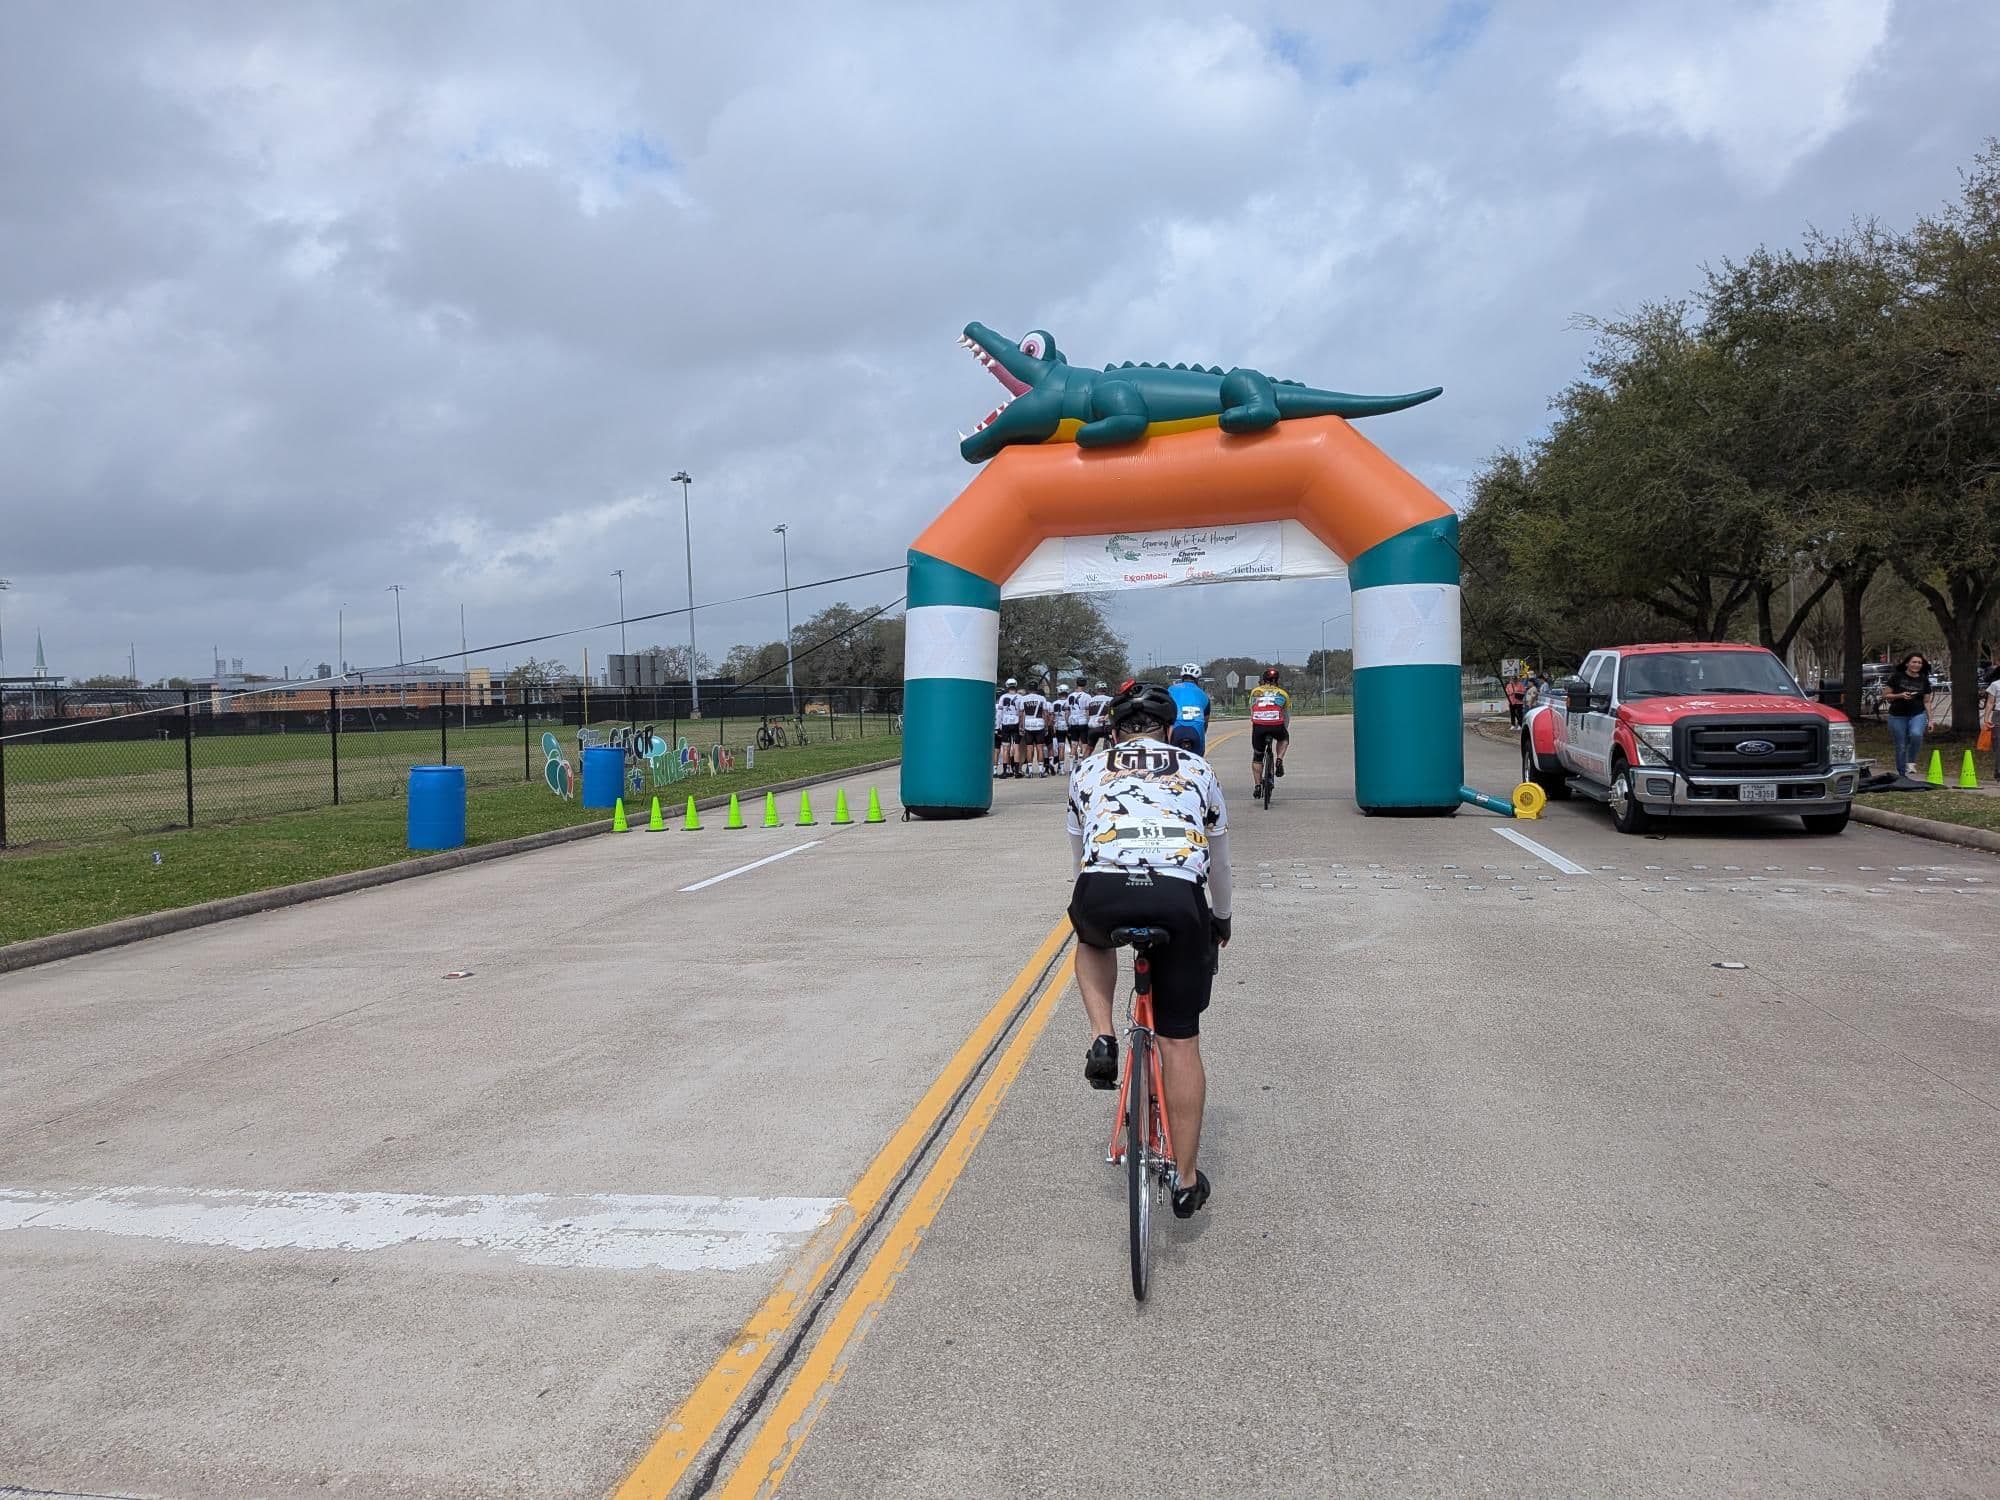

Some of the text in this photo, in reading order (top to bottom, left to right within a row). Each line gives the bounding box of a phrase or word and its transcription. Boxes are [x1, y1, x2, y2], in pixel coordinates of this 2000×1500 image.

[1170, 535, 1181, 549] Up
[1191, 532, 1208, 546] End
[1172, 556, 1198, 564] Phillips
[1123, 572, 1168, 583] ExxonMobil
[1137, 825, 1165, 839] 131
